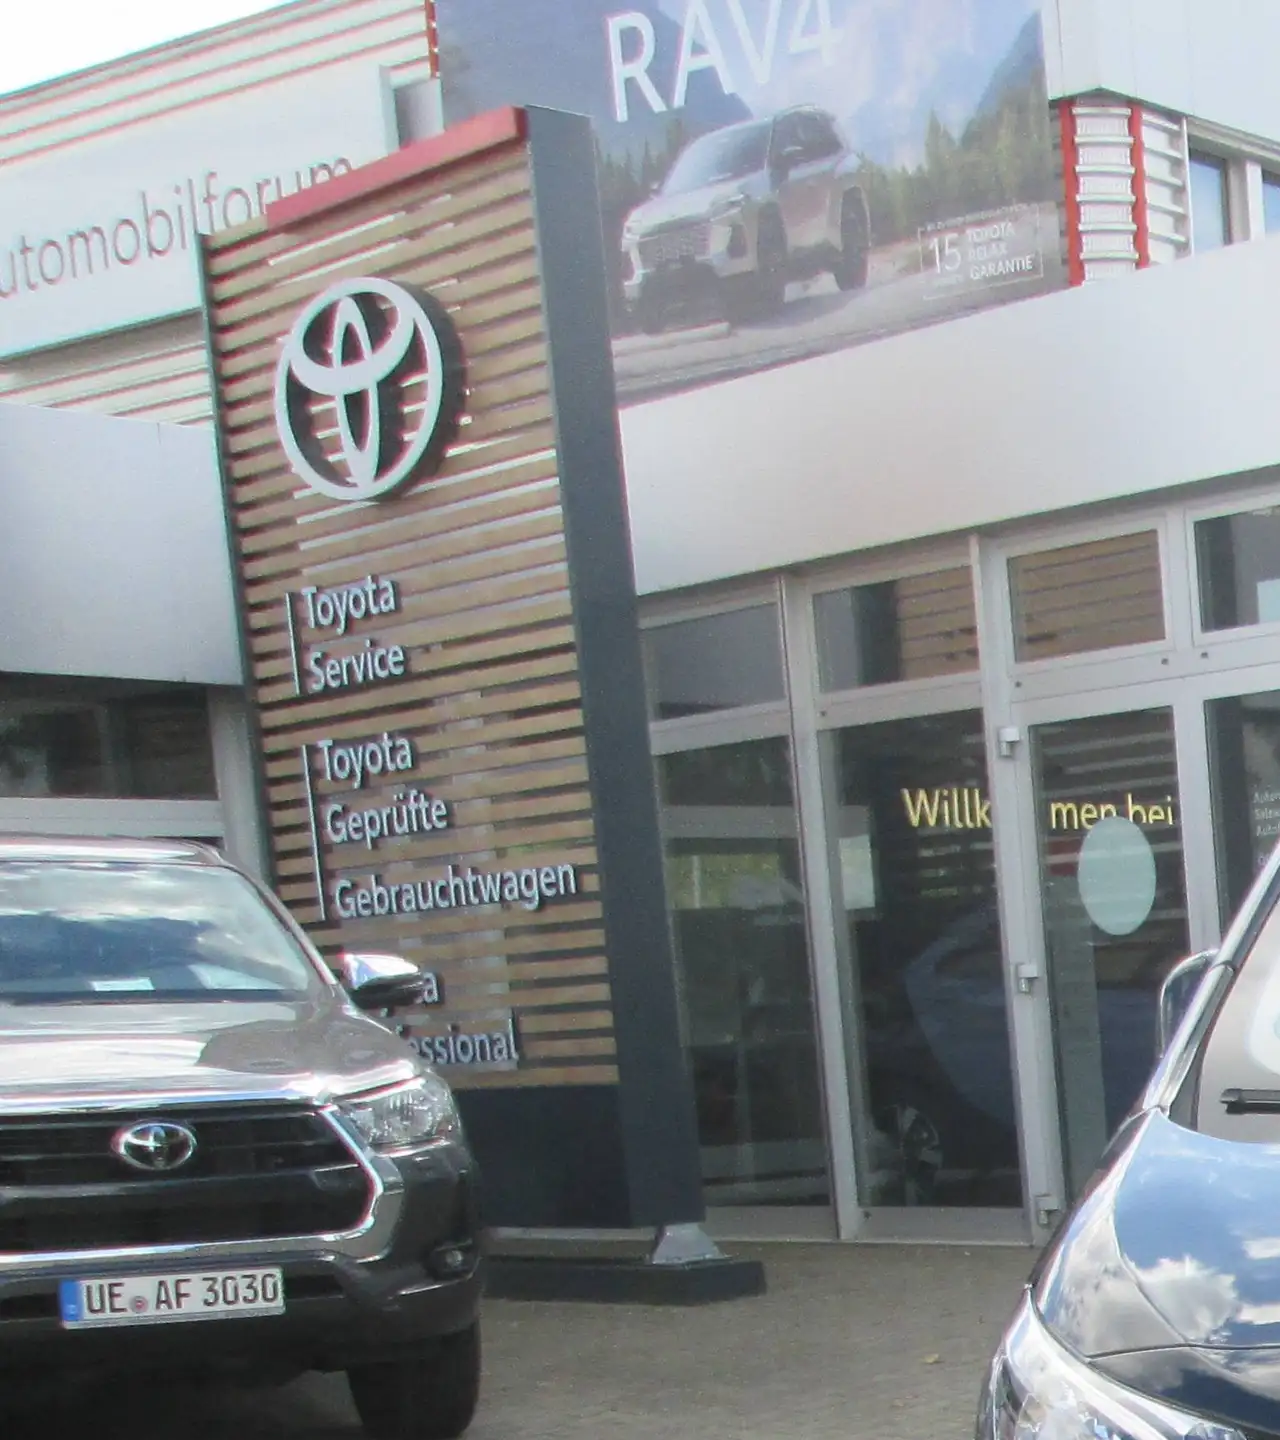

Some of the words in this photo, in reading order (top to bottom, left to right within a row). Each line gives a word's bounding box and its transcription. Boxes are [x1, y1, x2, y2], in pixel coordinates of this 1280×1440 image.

[608, 0, 844, 123] RAV4
[0, 157, 352, 298] utomobilforum
[929, 233, 962, 274] 15
[966, 221, 1016, 242] TOYOTA
[970, 255, 1034, 280] GARANTIE
[302, 575, 396, 635] Toyota
[309, 638, 405, 691] Service
[317, 732, 413, 789] Toyota
[326, 789, 448, 849] Geprüfte
[334, 864, 577, 918] Gebrauchtwagen
[86, 1283, 127, 1314] UE
[155, 1278, 192, 1310] AF
[202, 1273, 279, 1307] 3030
